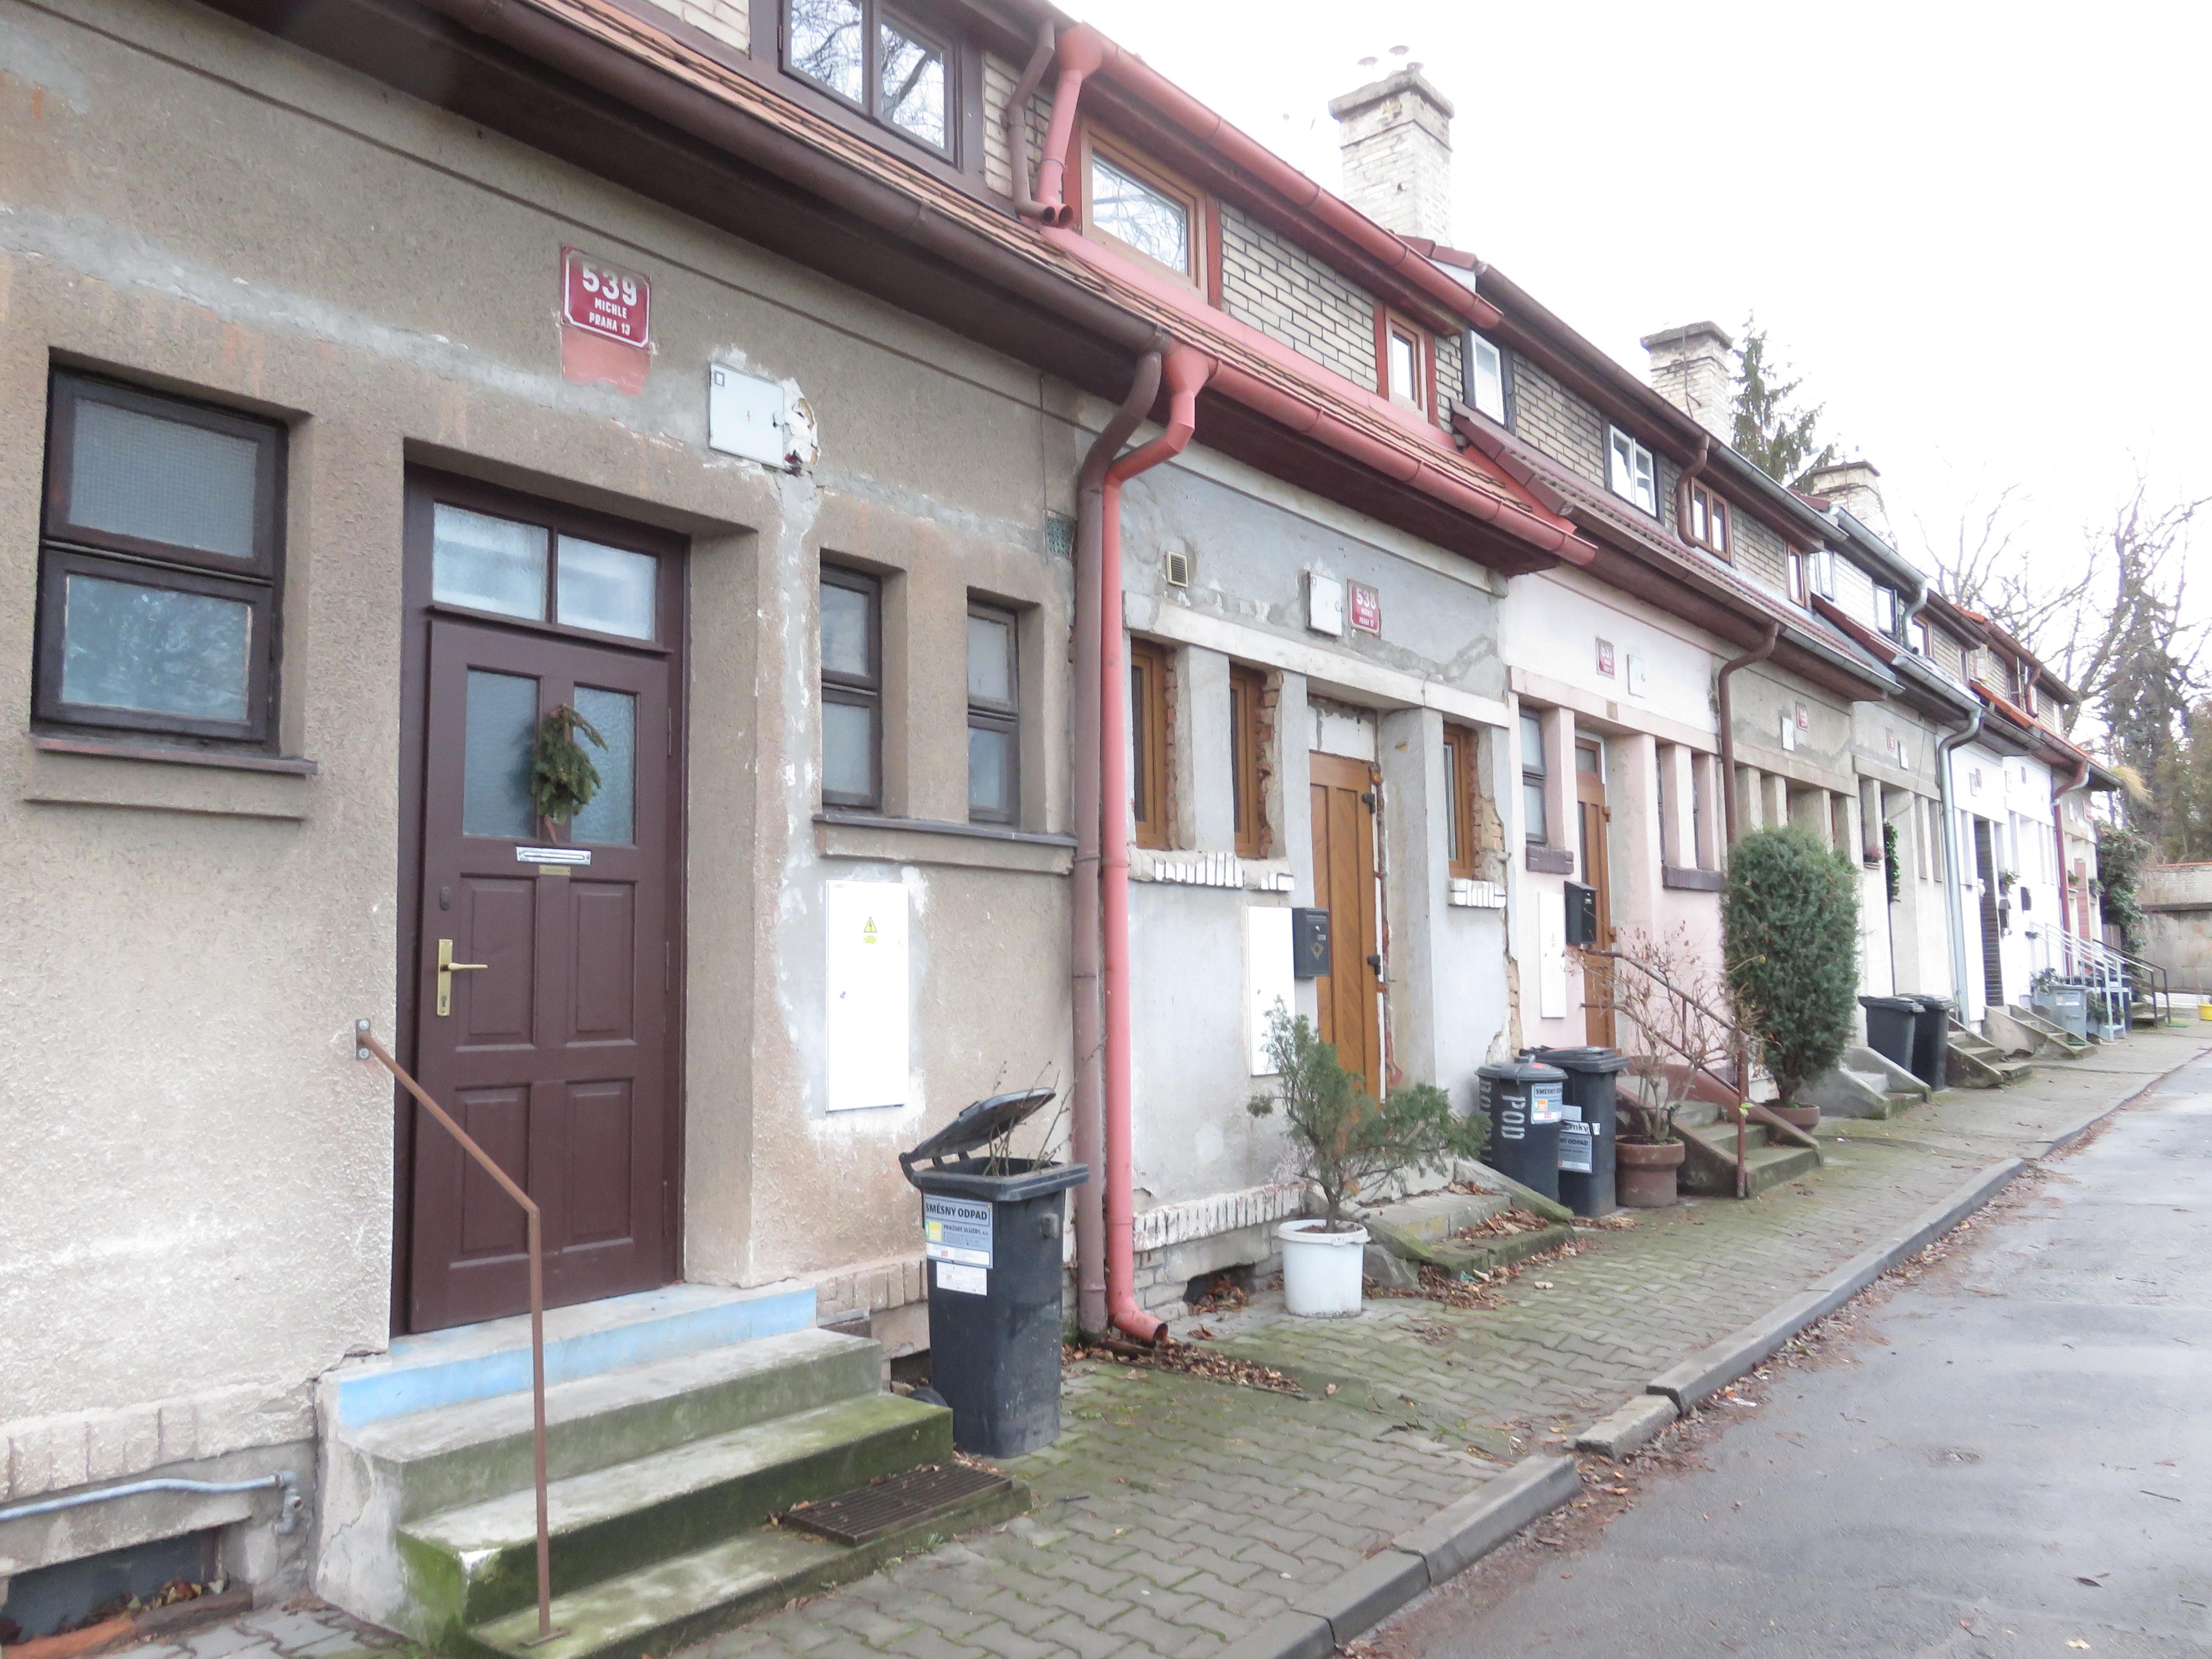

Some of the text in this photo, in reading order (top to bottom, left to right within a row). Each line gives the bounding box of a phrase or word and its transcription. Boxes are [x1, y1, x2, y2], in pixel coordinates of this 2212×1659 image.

[582, 262, 637, 306] 539
[594, 298, 628, 319] MICHLE
[589, 312, 631, 336] PRAHA 13
[1357, 587, 1376, 609] 538
[1501, 1095, 1526, 1139] POD
[925, 1202, 988, 1220] SMĚSNÝ ODPAD
